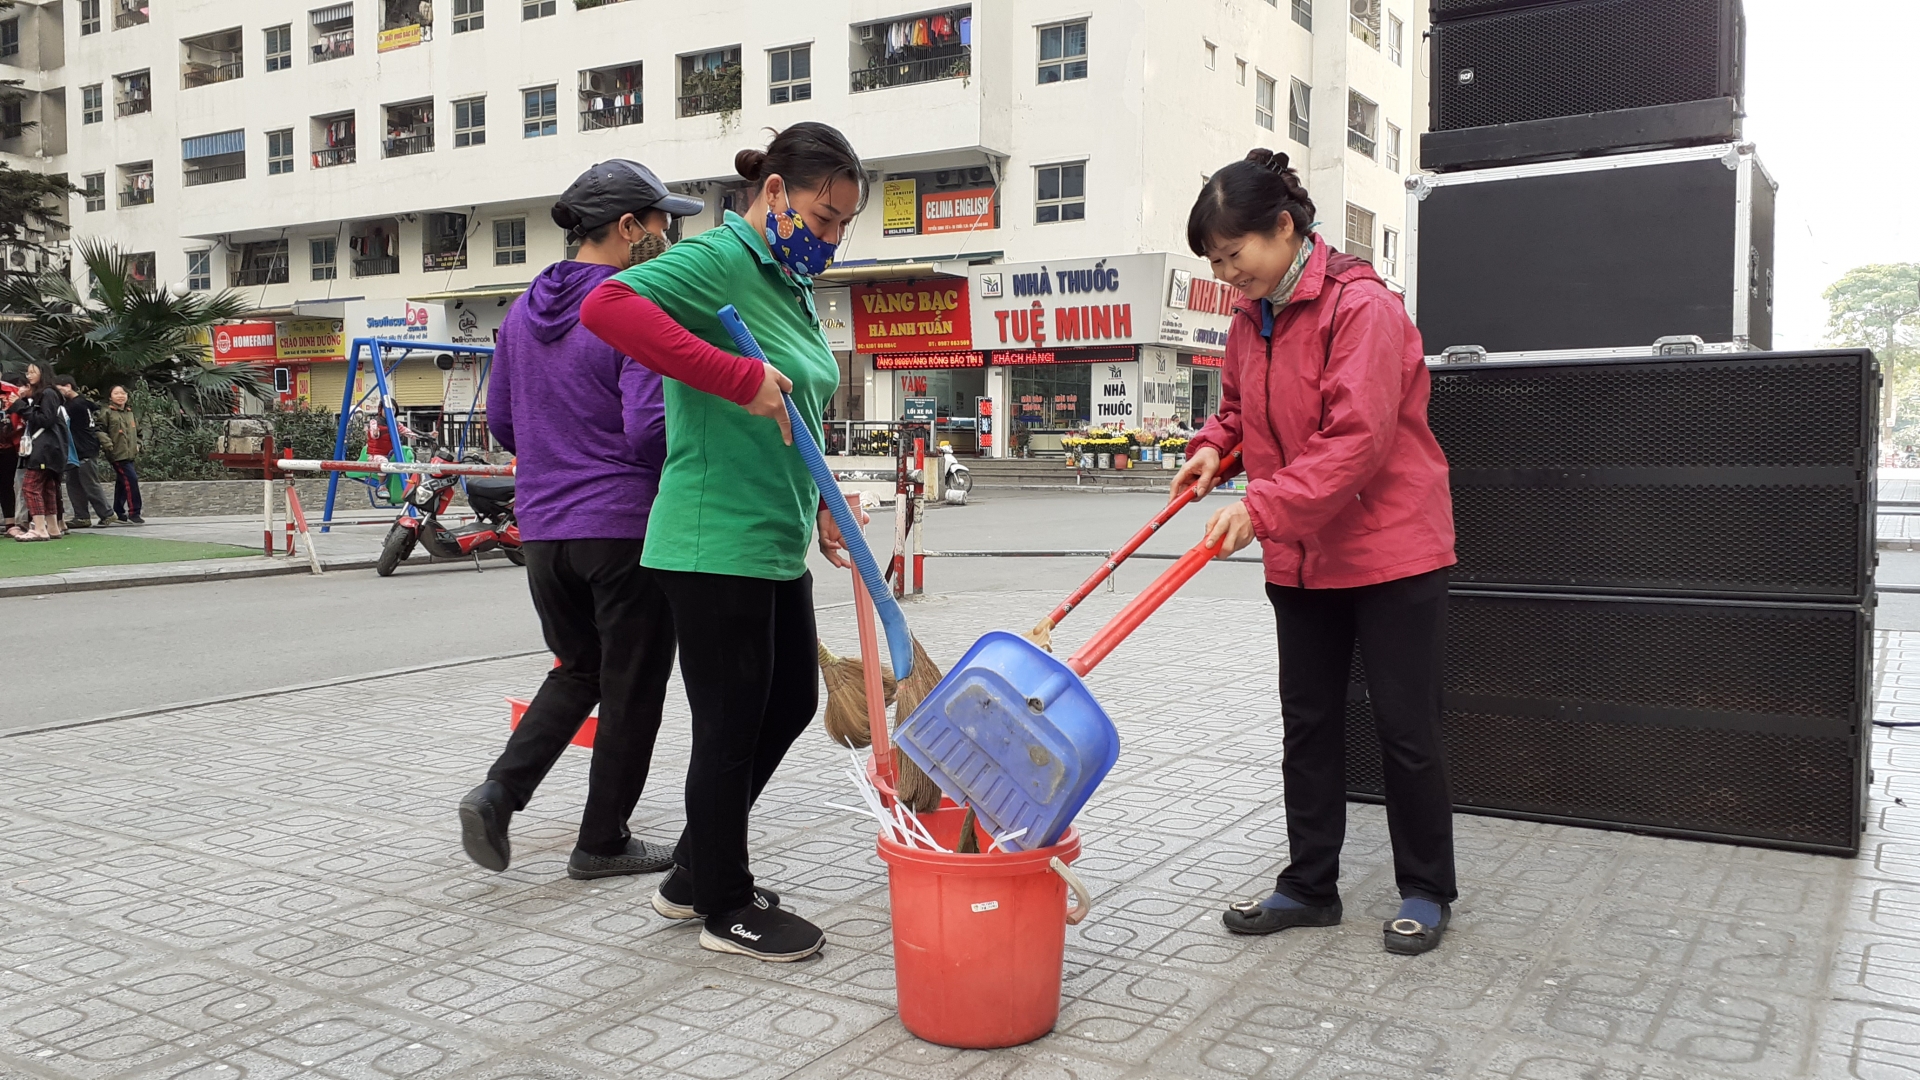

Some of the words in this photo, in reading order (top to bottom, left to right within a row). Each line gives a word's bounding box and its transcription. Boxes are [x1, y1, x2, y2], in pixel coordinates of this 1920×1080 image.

[925, 200, 954, 219] CELINA
[954, 196, 989, 217] ENGLISH
[1012, 265, 1052, 297] NHÀ
[1056, 258, 1119, 294] THUỐC
[861, 288, 915, 314] VÀNG
[919, 290, 958, 315] BẠC
[868, 320, 887, 337] HÀ
[889, 322, 917, 336] ANH
[917, 315, 953, 335] TUẤN
[994, 300, 1046, 348] TUỆ
[1055, 303, 1132, 341] MINH
[232, 334, 274, 348] HOMEFARM
[299, 336, 316, 348] DINH
[316, 332, 341, 346] DƯỠNG
[993, 351, 1026, 364] KHÁCH
[900, 371, 928, 392] VÀNG
[1103, 380, 1126, 397] NHÀ
[1144, 377, 1156, 404] NHÀ
[1157, 376, 1175, 405] THUỐC
[906, 406, 916, 415] LỐI
[1097, 399, 1133, 416] THUỐC
